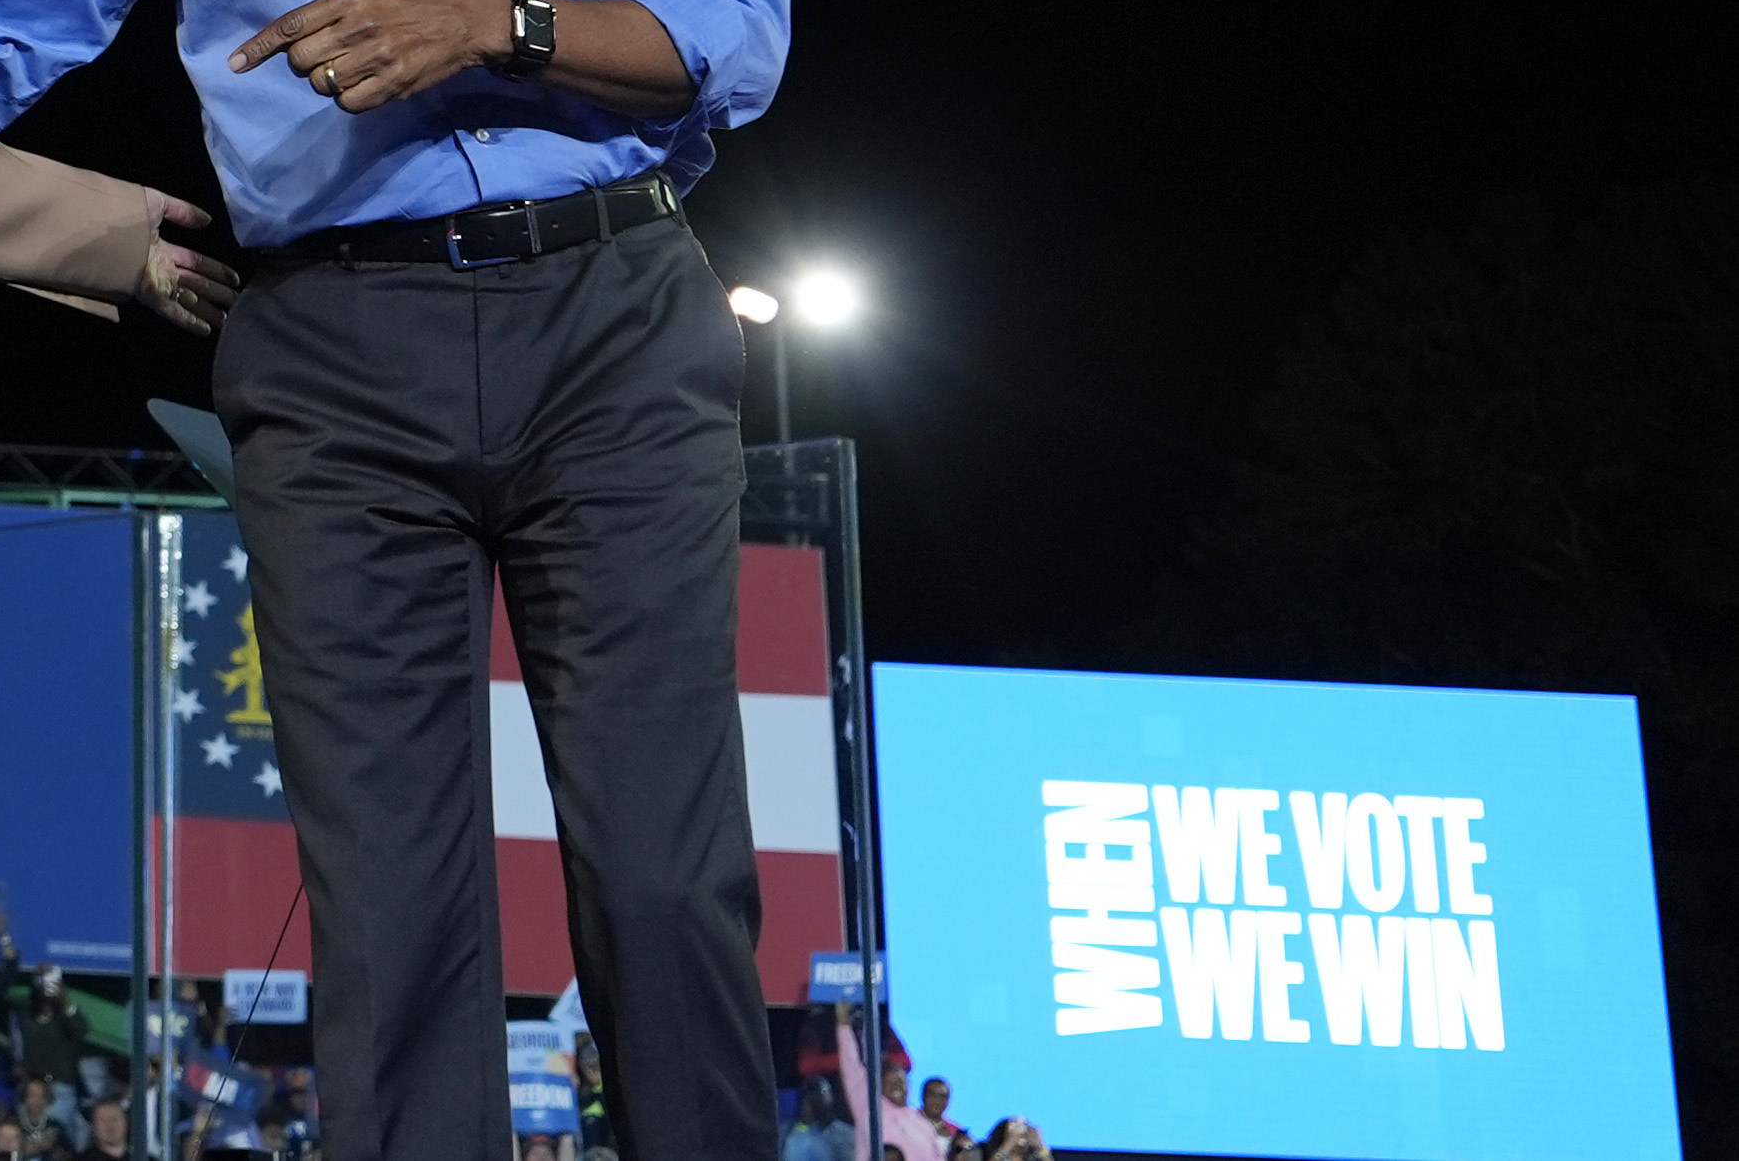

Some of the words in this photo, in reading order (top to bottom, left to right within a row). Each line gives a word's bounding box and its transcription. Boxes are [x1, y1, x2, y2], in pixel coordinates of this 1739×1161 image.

[1042, 779, 1165, 1037] WHEN
[1152, 784, 1288, 907] WE
[1289, 790, 1493, 916] VOTE
[1160, 907, 1312, 1044] WE
[1307, 913, 1506, 1052] WIN
